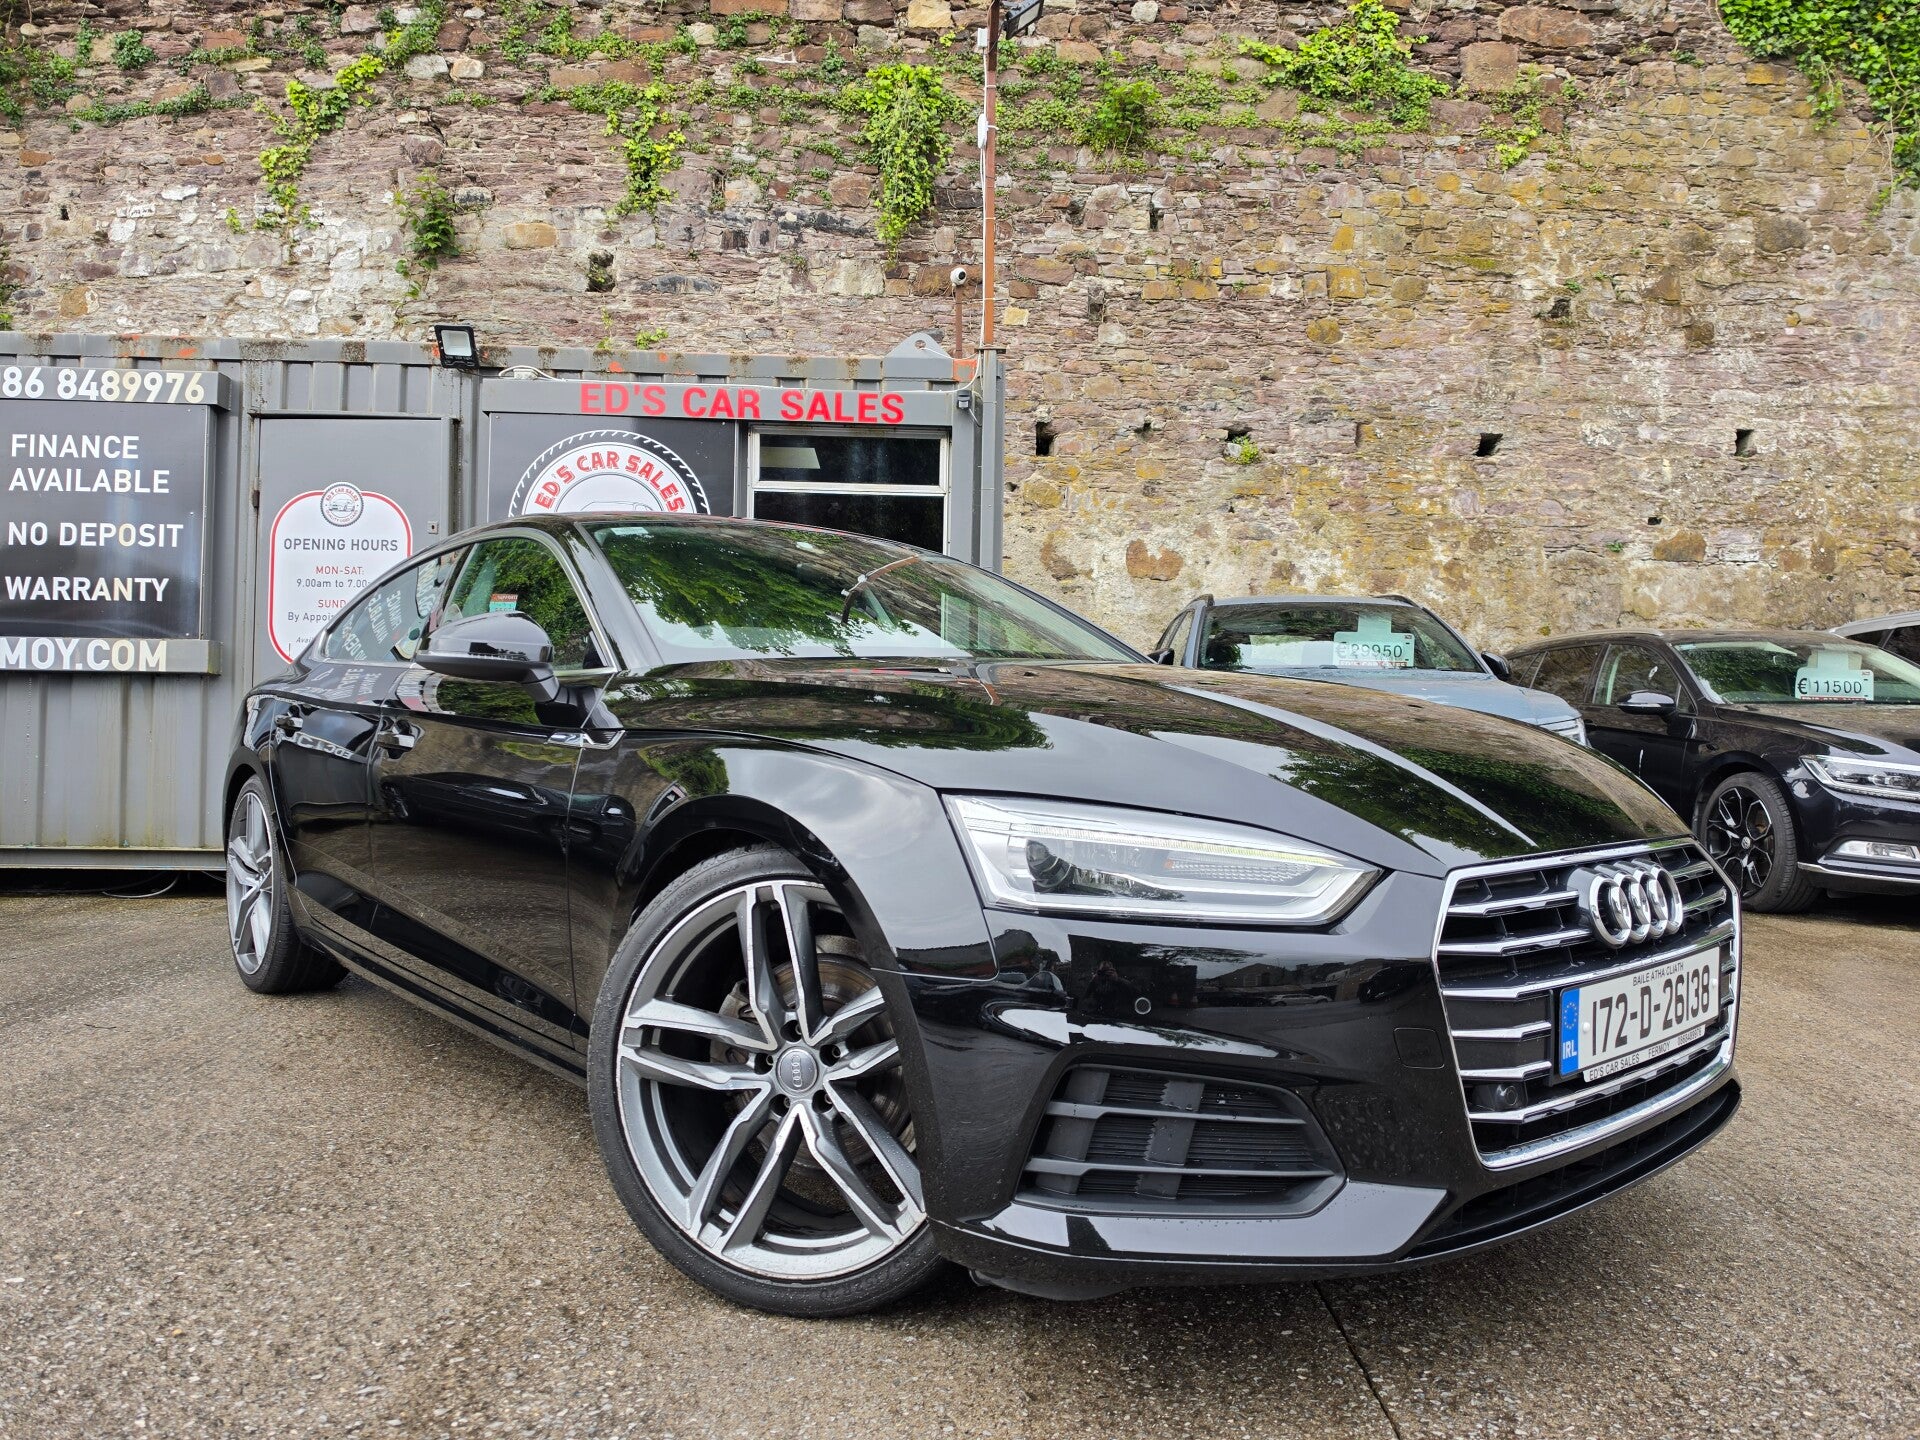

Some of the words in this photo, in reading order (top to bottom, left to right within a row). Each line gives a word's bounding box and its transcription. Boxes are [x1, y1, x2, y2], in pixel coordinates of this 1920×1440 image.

[2, 366, 44, 398] 86
[57, 368, 205, 403] 8489976
[580, 383, 666, 415] ED'S
[682, 388, 761, 418] CAR
[781, 392, 905, 424] SALES
[11, 434, 140, 459] FINANCE
[9, 468, 170, 493] AVAILABLE
[535, 465, 576, 509] ED'S
[577, 451, 619, 472] CAR
[625, 455, 685, 512] SALES
[8, 522, 48, 546] NO
[59, 523, 184, 547] DEPOSIT
[284, 538, 346, 551] OPENING
[351, 539, 398, 552] HOURS
[5, 576, 169, 602] WARRANTY
[296, 579, 332, 588] 9.00am
[335, 579, 344, 588] to
[318, 599, 347, 608] SUND
[288, 612, 300, 622] By
[0, 637, 167, 671] MOY.COM
[1632, 972, 1650, 986] BAILE
[1592, 964, 1710, 1056] 172-D-26138
[1562, 1041, 1577, 1060] IRL
[1589, 1065, 1604, 1081] ED'S
[1605, 1060, 1619, 1075] CAR
[1620, 1053, 1640, 1069] SALES
[1648, 1041, 1671, 1058] FERMOY
